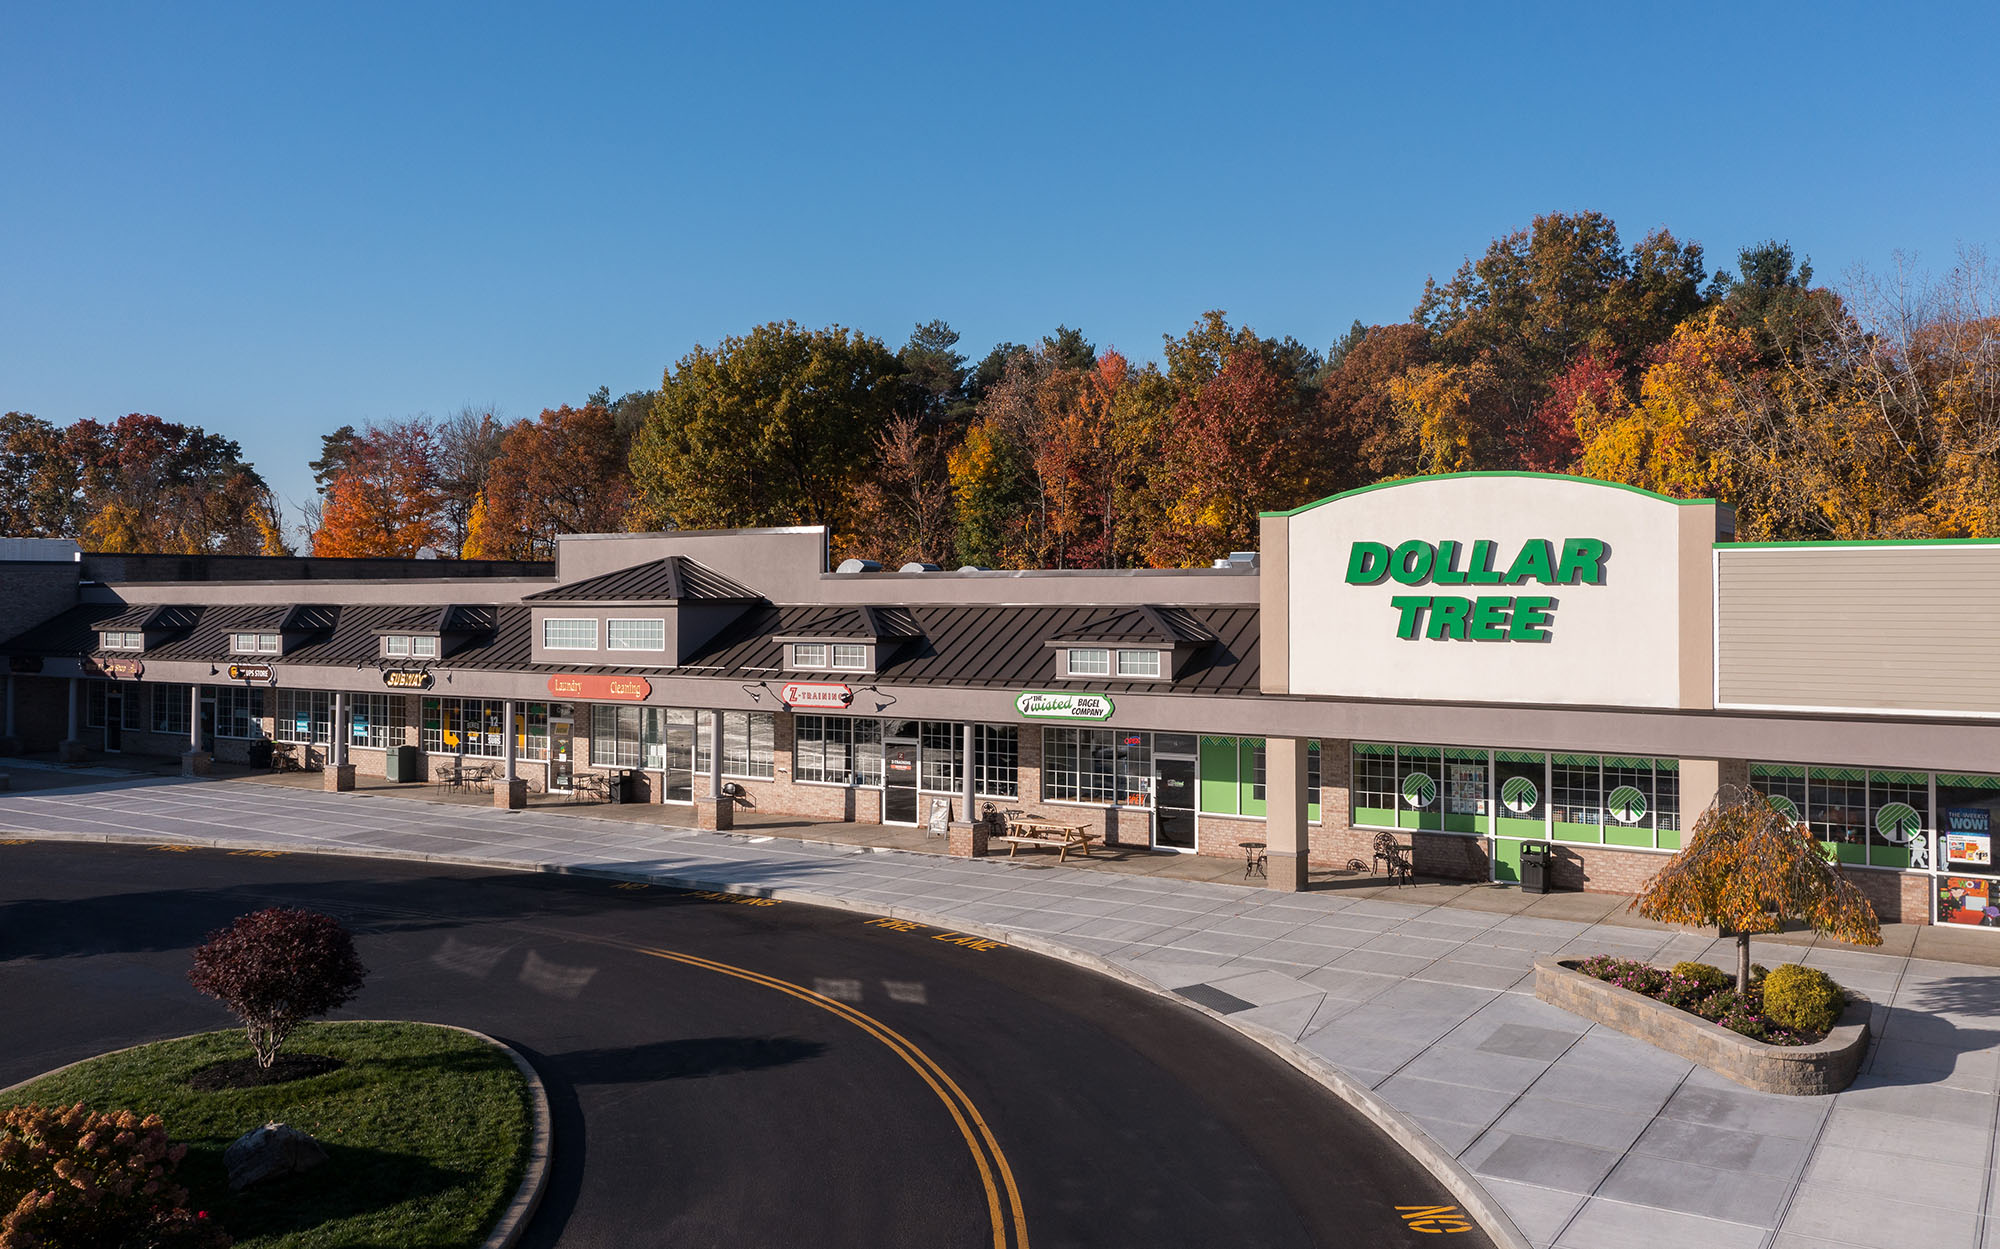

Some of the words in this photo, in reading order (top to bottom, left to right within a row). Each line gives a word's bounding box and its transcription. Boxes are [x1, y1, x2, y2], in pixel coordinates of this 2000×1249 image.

[1345, 538, 1611, 586] DOLLAR
[1391, 596, 1559, 643] TREE
[255, 670, 268, 678] STORE
[387, 672, 427, 686] SUBWAY
[555, 680, 581, 695] Laundry
[610, 681, 640, 697] Cleaning
[1022, 695, 1072, 712] Twisted
[1078, 698, 1100, 707] BAGEL
[1071, 707, 1104, 716] COMPANY
[1950, 818, 1989, 830] WOW!
[1958, 880, 1985, 892] WOW!
[863, 918, 928, 932] FIRE
[930, 932, 1009, 952] LANE
[1394, 1205, 1473, 1234] NO
